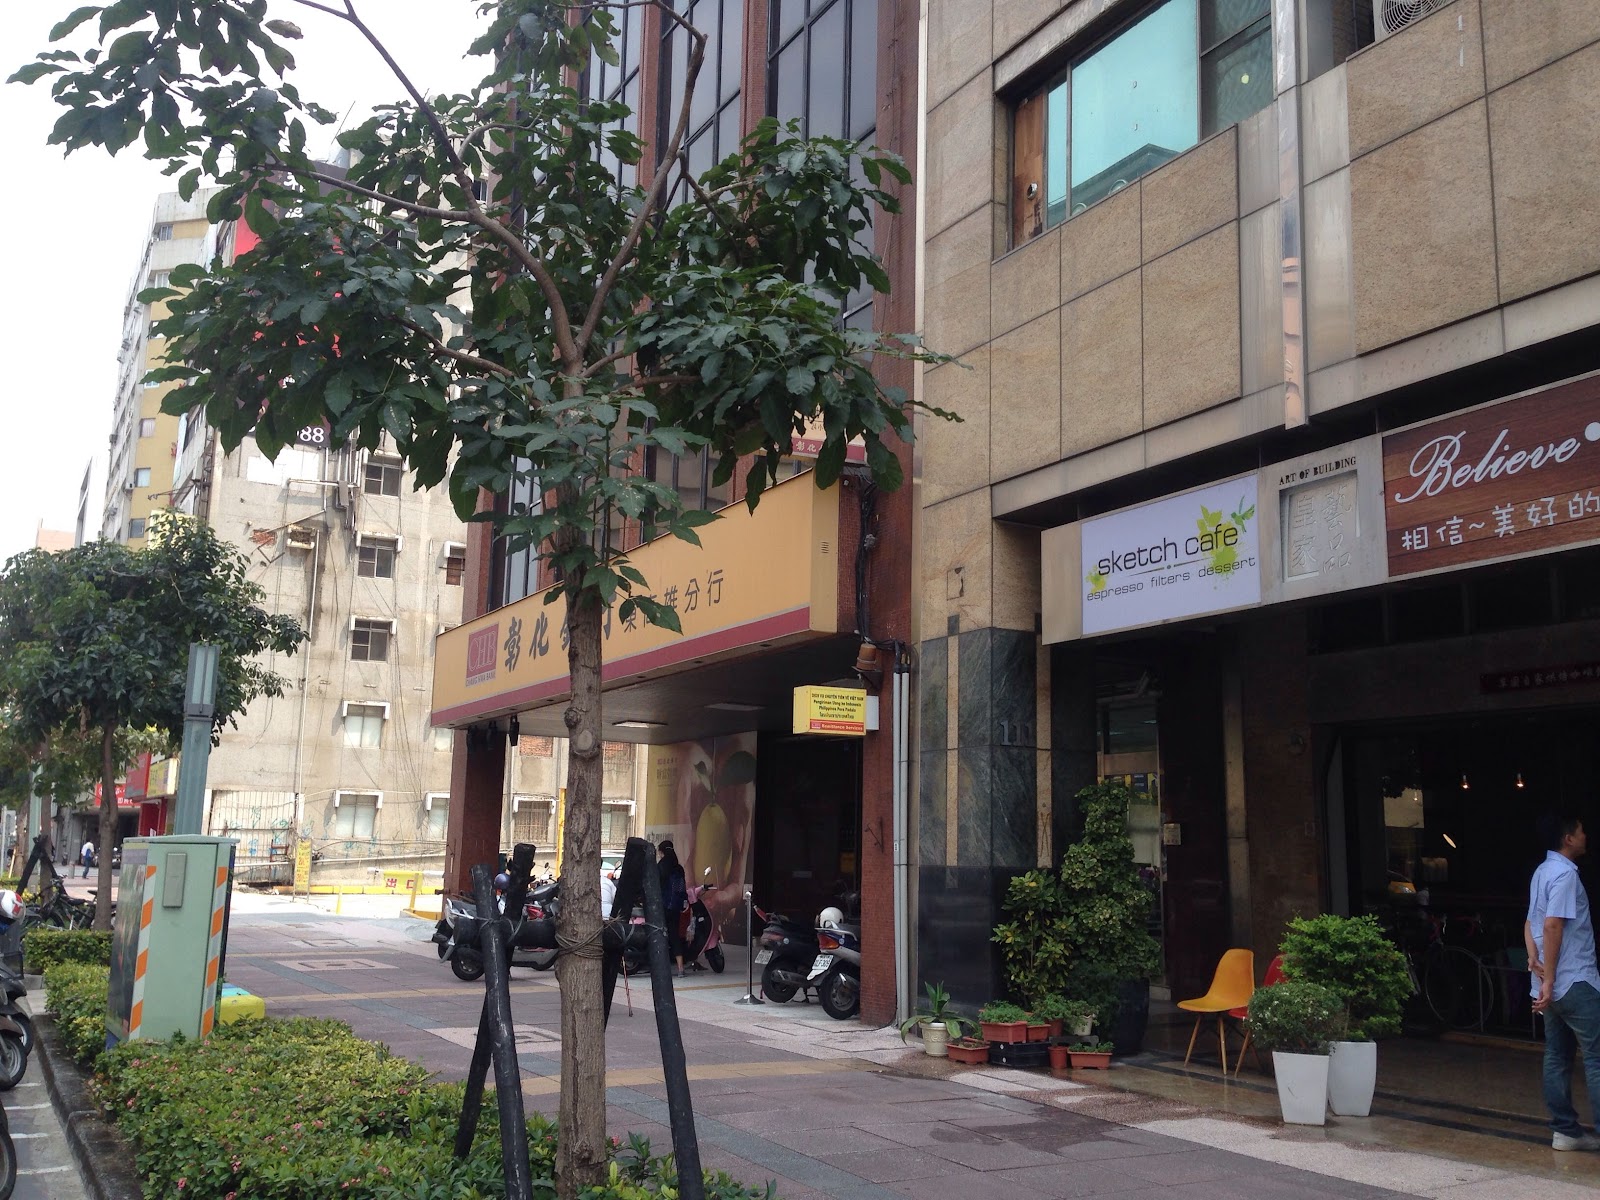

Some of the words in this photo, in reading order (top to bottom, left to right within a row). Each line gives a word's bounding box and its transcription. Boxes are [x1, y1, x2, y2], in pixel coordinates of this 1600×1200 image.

[296, 425, 324, 443] 88
[796, 440, 823, 453] 彰化
[1279, 473, 1297, 486] ART
[1299, 468, 1311, 480] OF
[1313, 456, 1357, 477] BUILDING
[1394, 429, 1581, 503] Believe
[1098, 537, 1178, 576] sketch
[1185, 523, 1238, 556] cafe
[1086, 582, 1144, 602] espresso
[1151, 571, 1190, 588] filters
[1198, 557, 1256, 578] dessert
[468, 630, 497, 671] CHB
[504, 592, 617, 673] 彰化
[1000, 719, 1035, 746] 111
